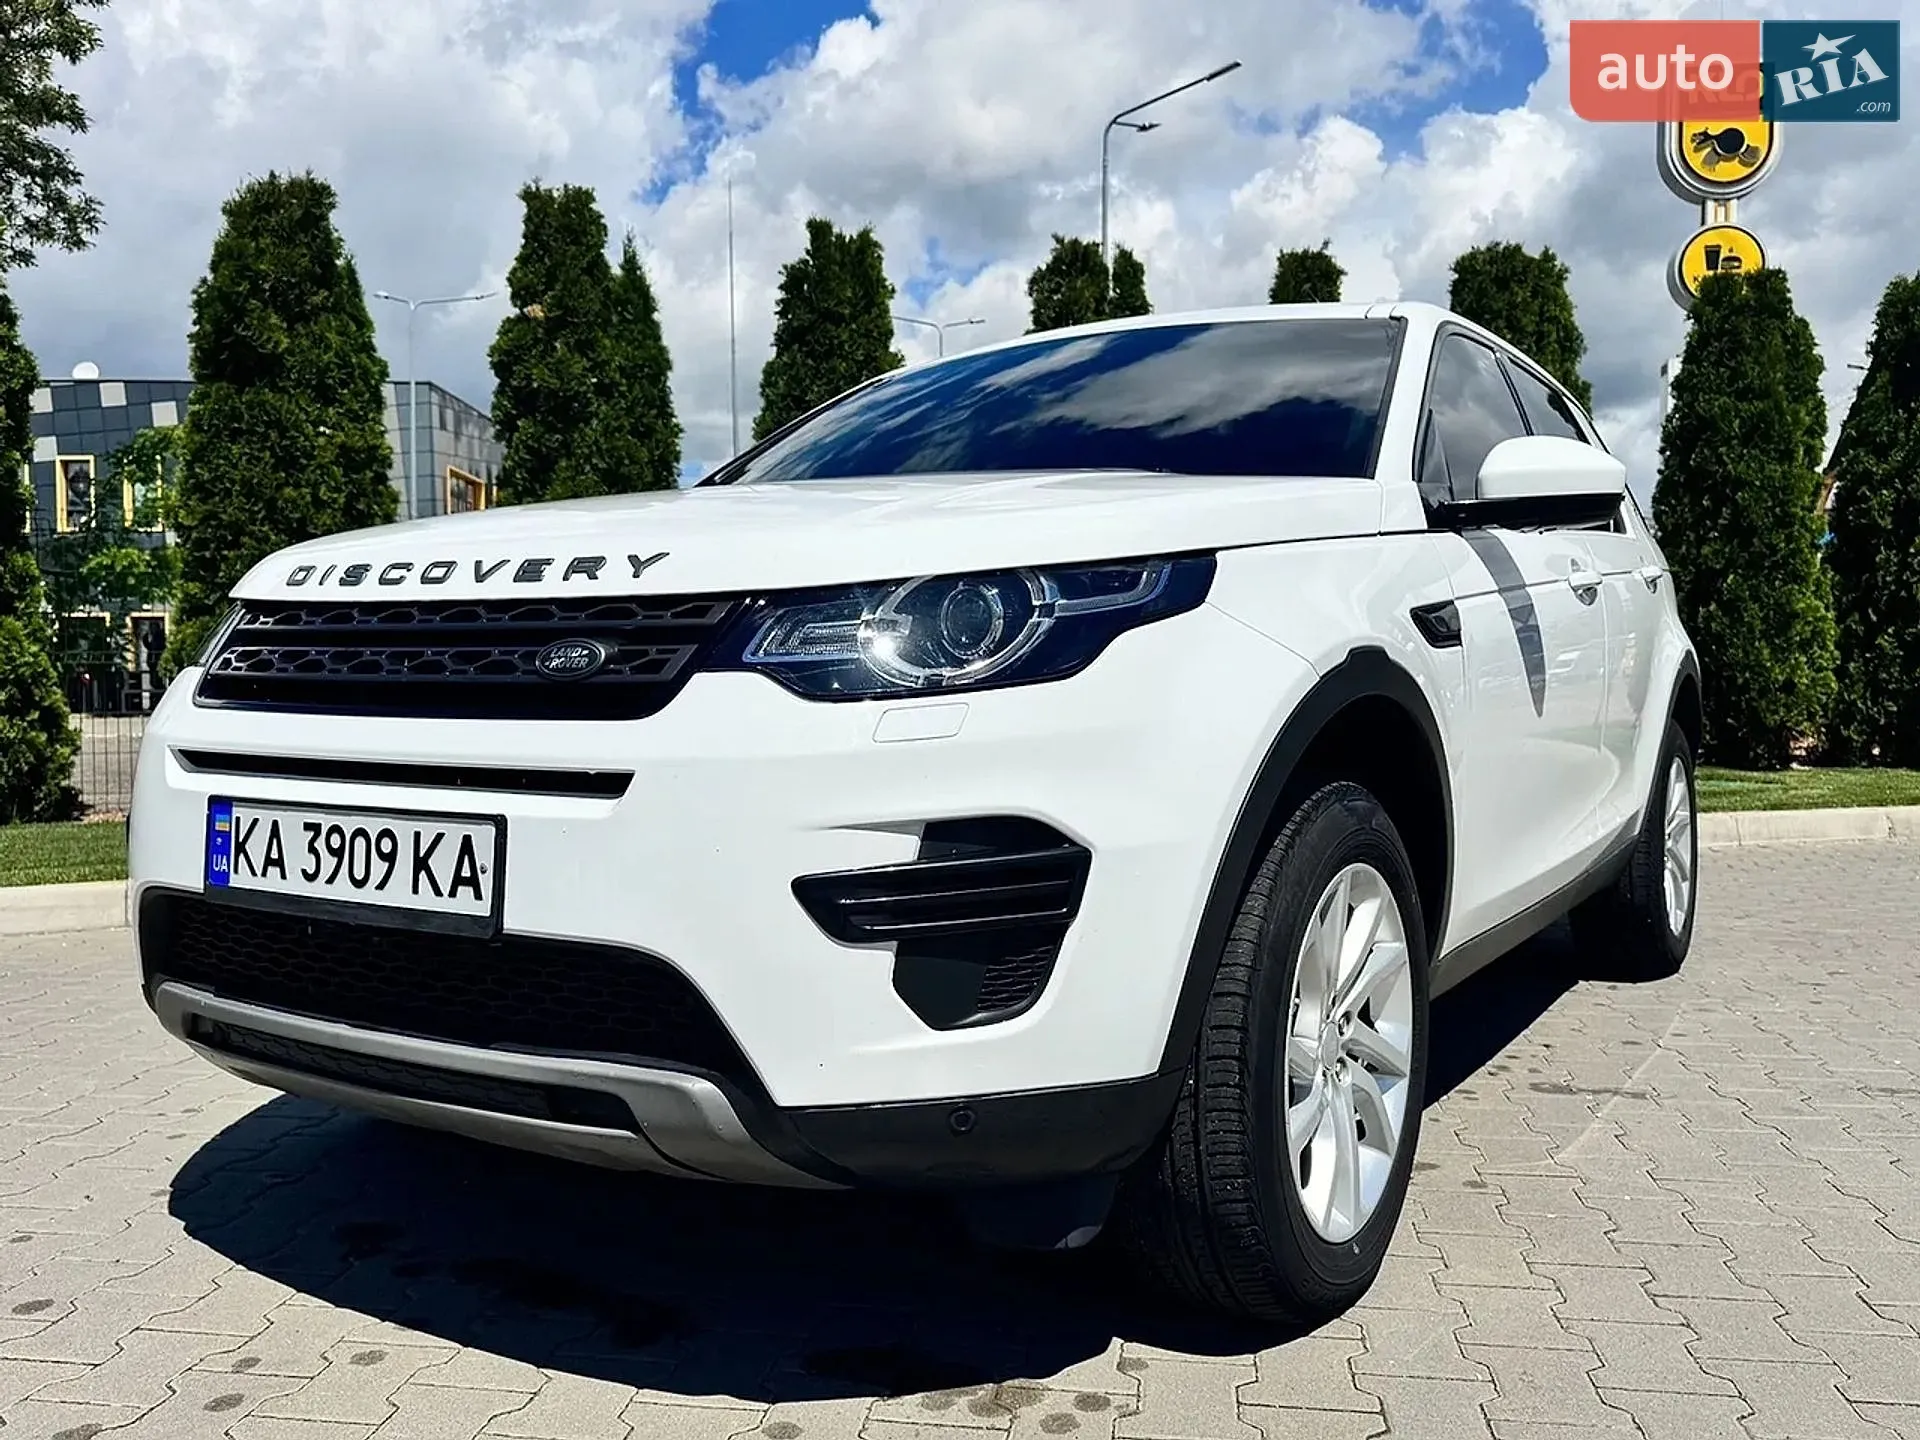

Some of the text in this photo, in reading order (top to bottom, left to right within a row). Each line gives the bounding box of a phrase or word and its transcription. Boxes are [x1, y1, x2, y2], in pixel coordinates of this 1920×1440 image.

[286, 551, 670, 586] DISCOVERY
[550, 647, 582, 658] LAND
[548, 657, 589, 669] ROVER
[212, 854, 229, 873] UA
[233, 815, 484, 901] KA 3909 KA
